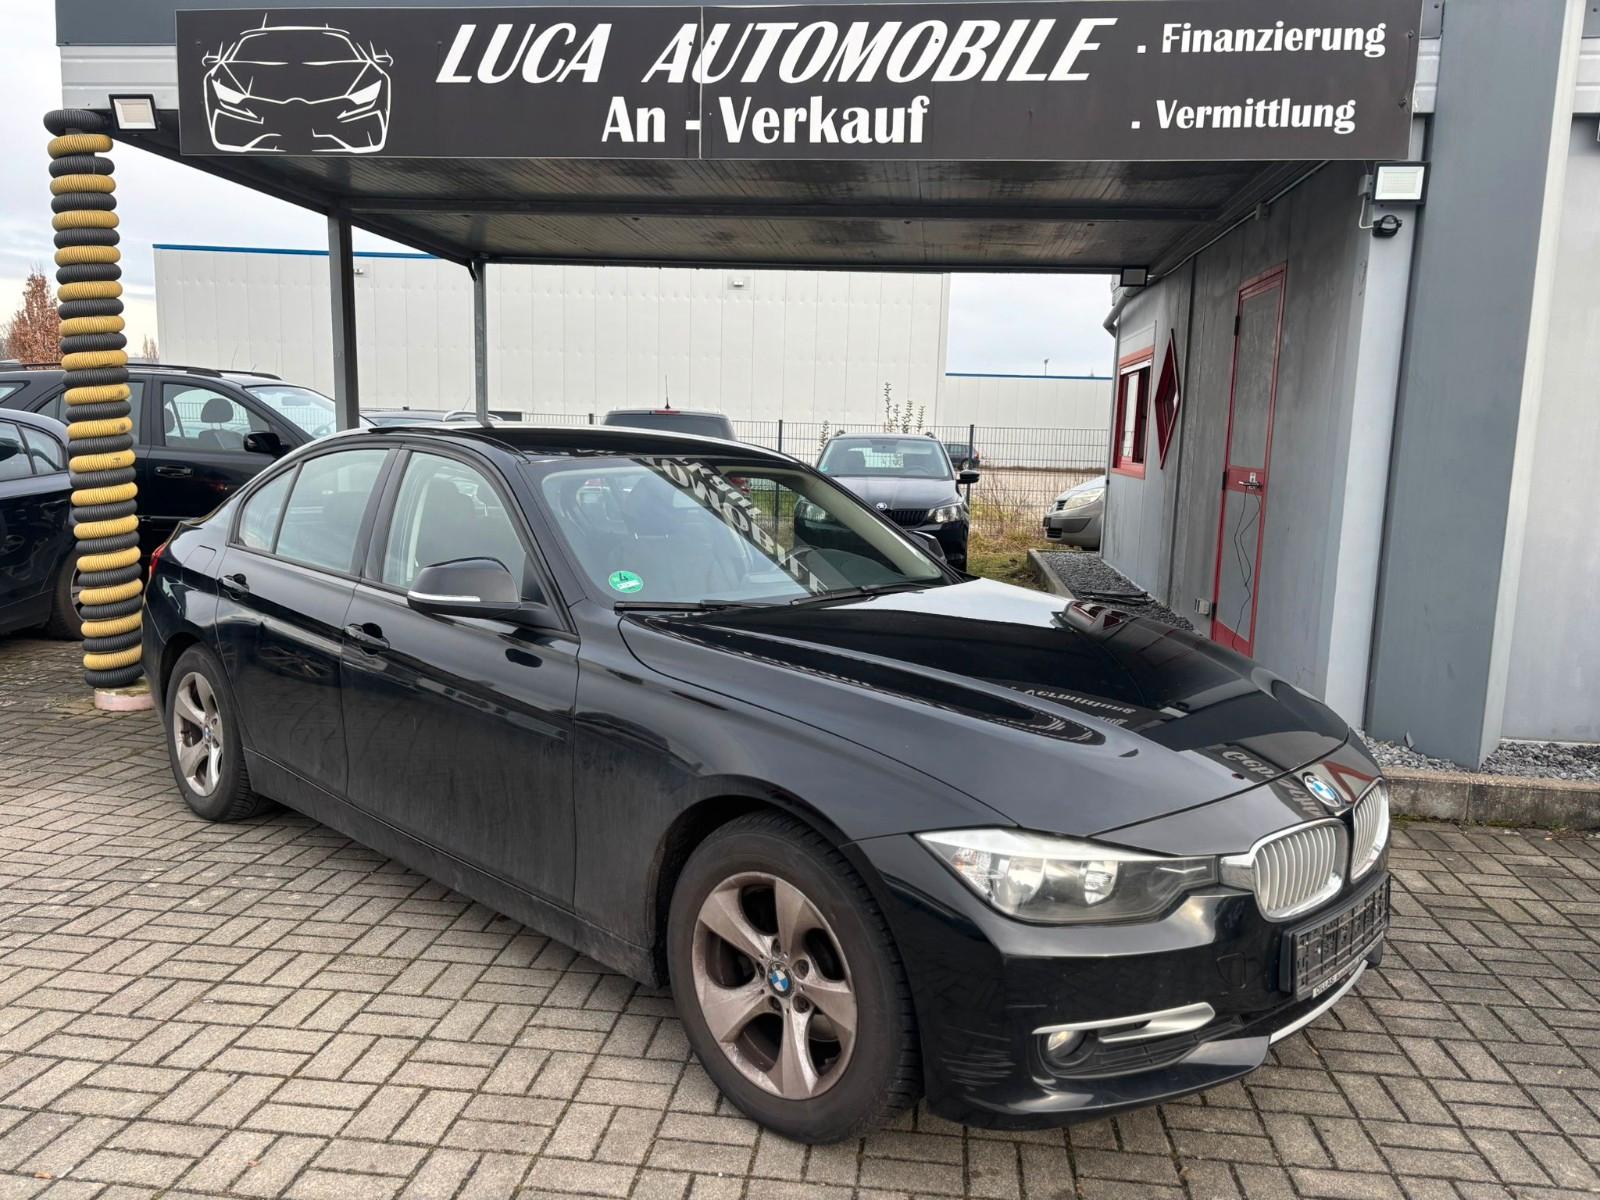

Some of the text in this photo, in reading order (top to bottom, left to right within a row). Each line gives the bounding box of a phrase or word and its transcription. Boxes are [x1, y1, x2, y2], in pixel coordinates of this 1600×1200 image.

[436, 17, 1118, 84] LUCA AUTOMOBILE
[1161, 20, 1387, 58] Finanzierung
[602, 96, 666, 143] An
[718, 95, 930, 144] Verkauf
[1156, 97, 1356, 135] Vermittlung
